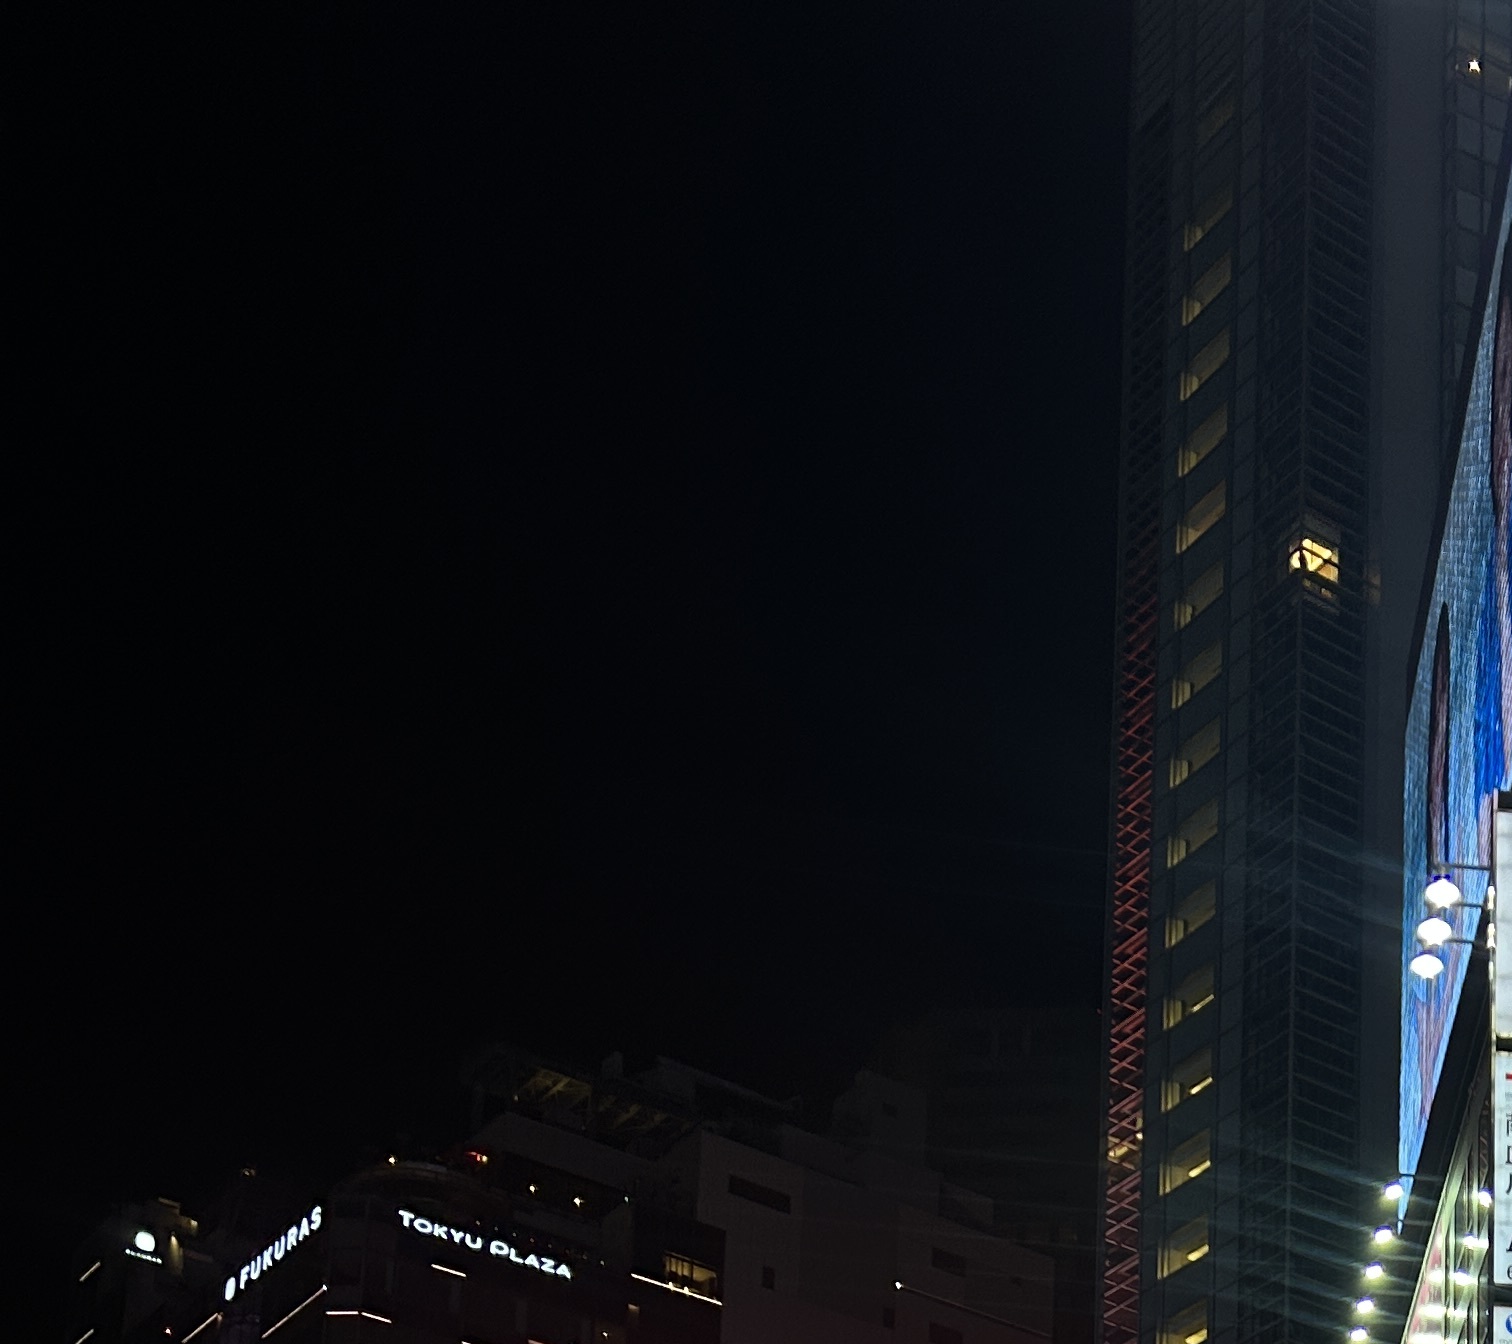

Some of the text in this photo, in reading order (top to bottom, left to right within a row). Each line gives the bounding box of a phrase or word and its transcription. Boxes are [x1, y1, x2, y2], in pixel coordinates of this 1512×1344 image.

[240, 1205, 322, 1289] FUKURAS
[398, 1209, 572, 1280] TOKYU PLAZA
